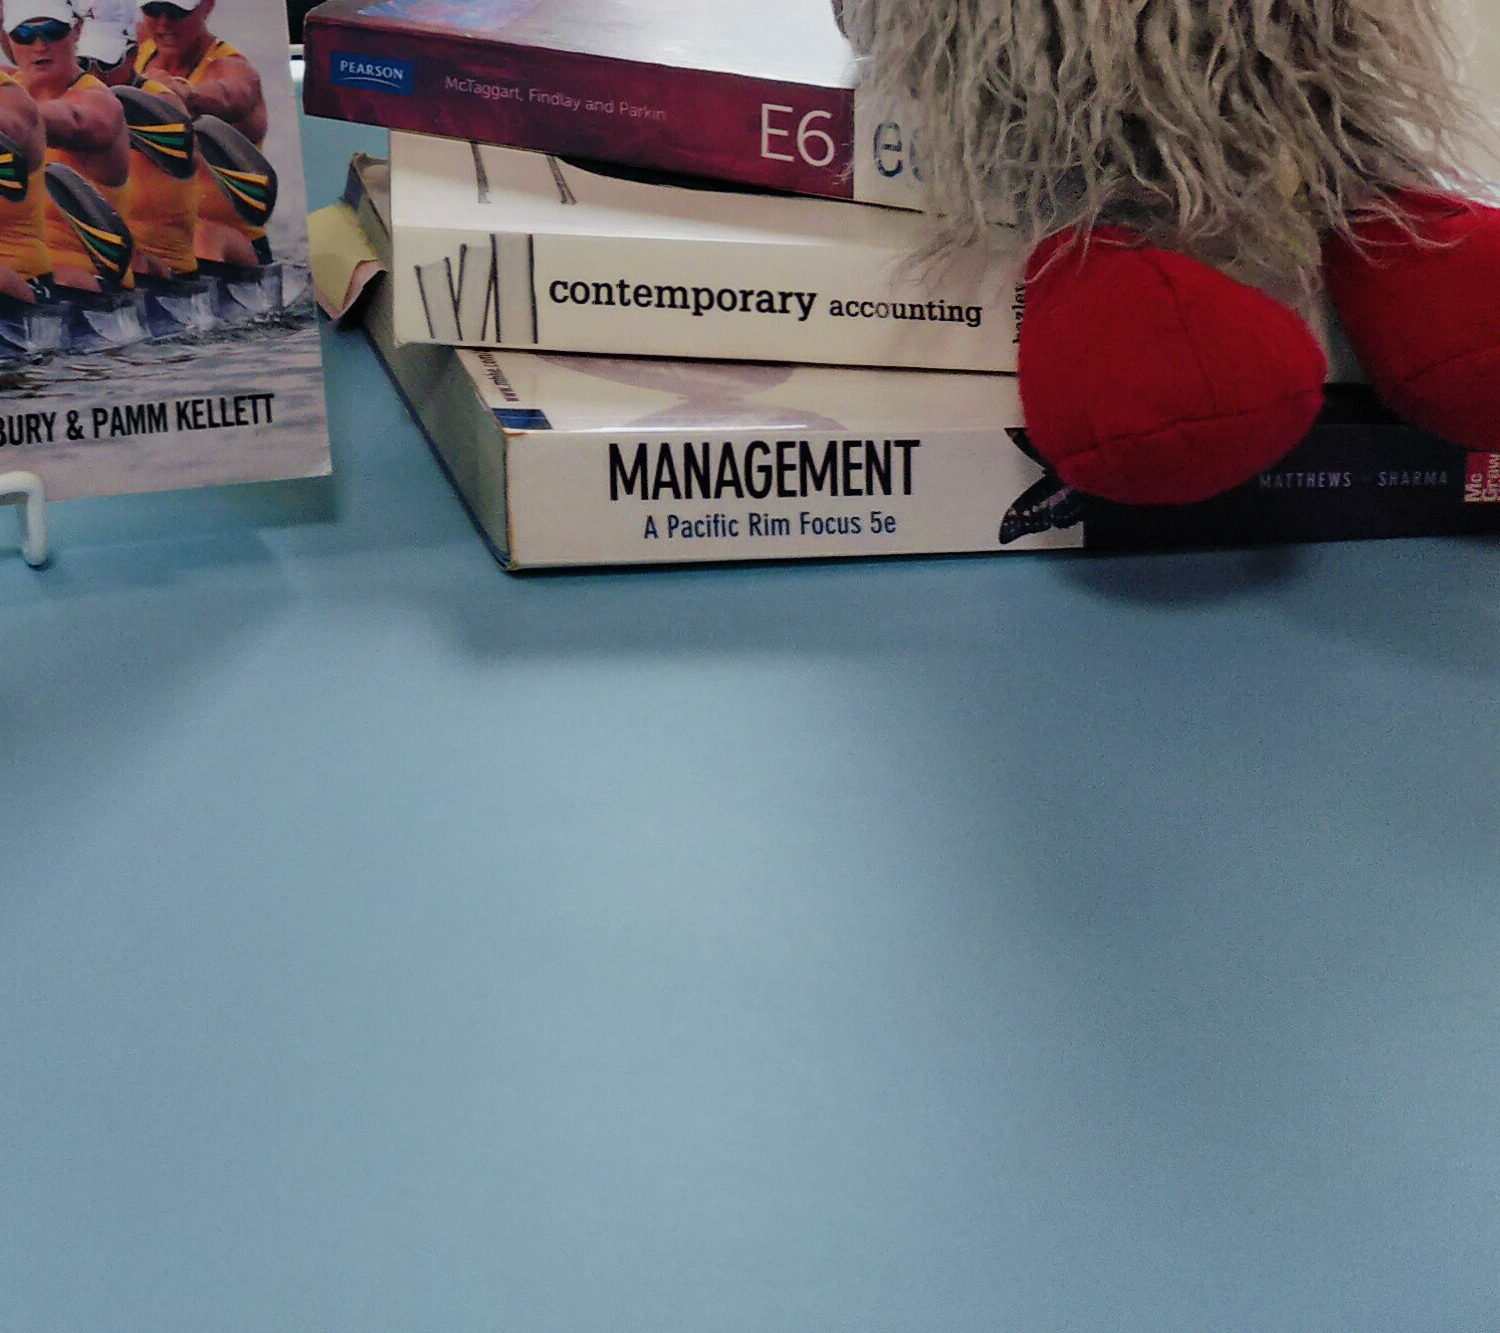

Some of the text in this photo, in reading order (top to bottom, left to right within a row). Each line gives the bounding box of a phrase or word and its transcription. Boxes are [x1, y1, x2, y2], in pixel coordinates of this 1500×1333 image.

[340, 59, 404, 81] PEARSON
[445, 76, 524, 101] McTaggart,
[528, 88, 580, 112] Findlay
[585, 98, 614, 114] and
[761, 103, 835, 167] E6
[549, 278, 983, 328] contemporary accounting
[66, 409, 85, 441] &
[92, 401, 169, 440] PAMM
[176, 393, 276, 432] KELLETT
[609, 439, 921, 501] MANAGEMENT
[1258, 469, 1448, 489] MATTHEWS SHARMA
[644, 510, 897, 540] A Pacific Rim Focus 5e
